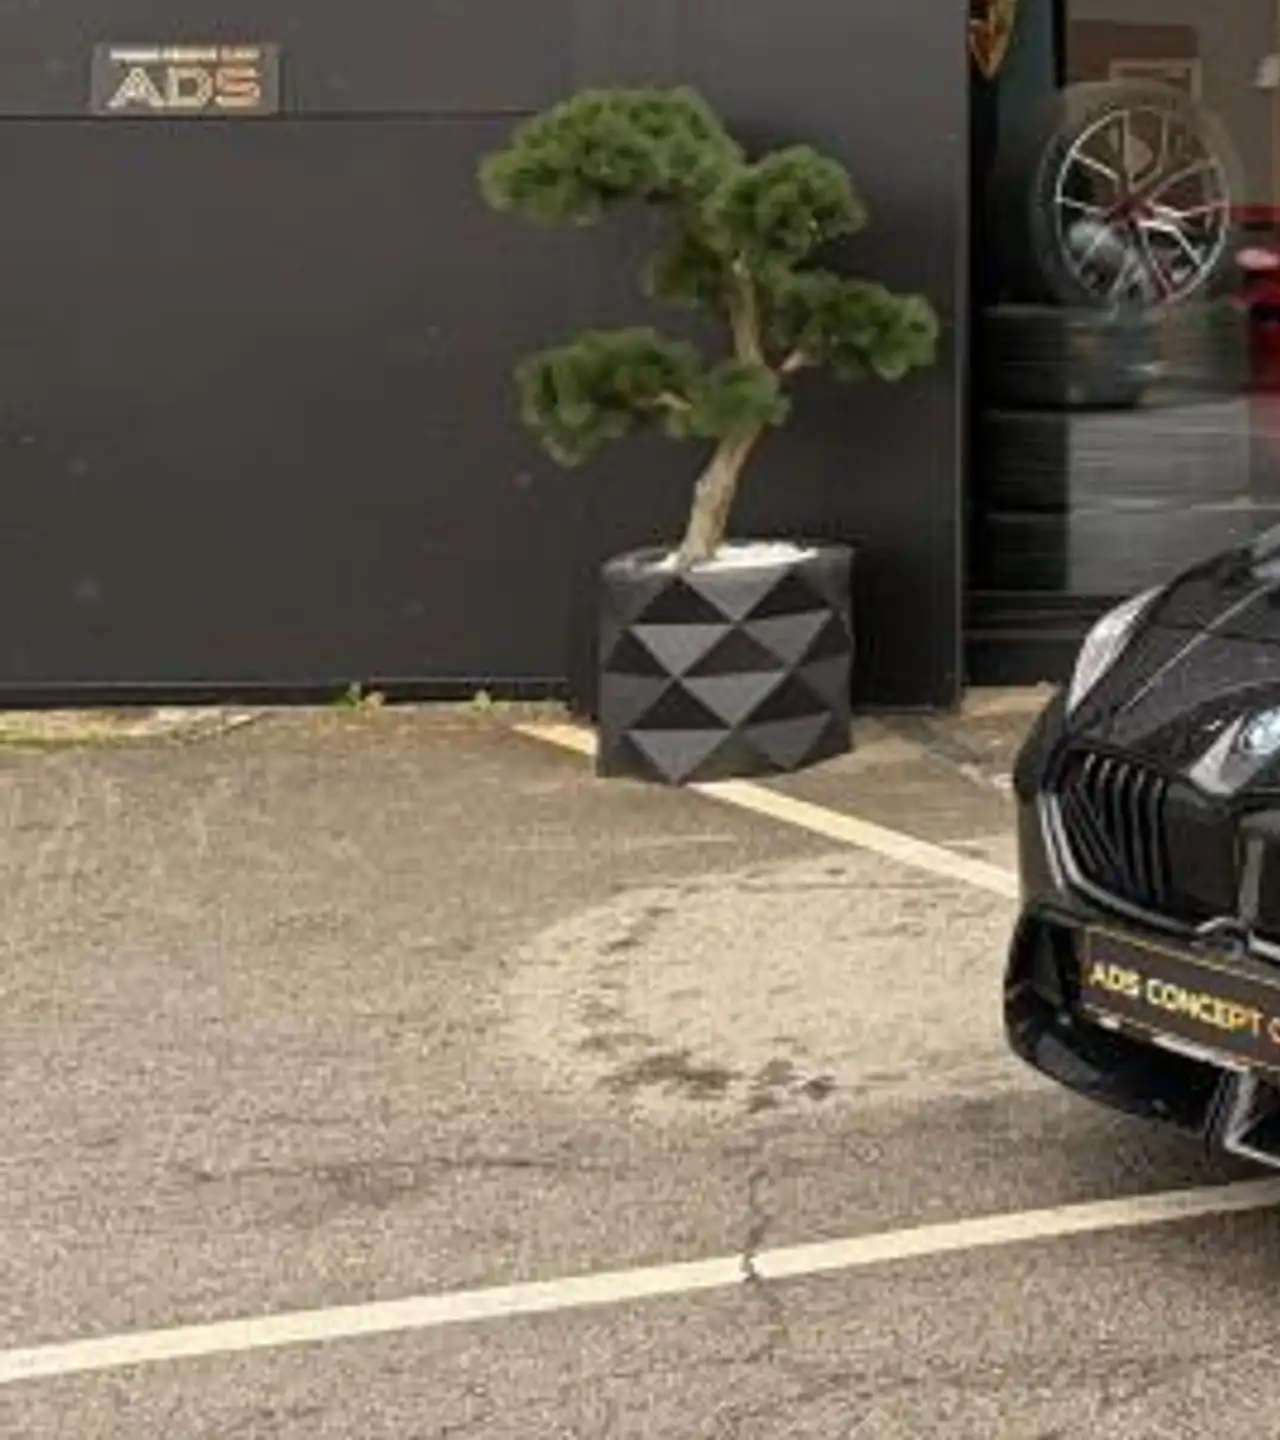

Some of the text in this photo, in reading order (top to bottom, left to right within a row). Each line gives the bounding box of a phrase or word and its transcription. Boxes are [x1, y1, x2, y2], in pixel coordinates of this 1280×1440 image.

[108, 66, 260, 107] ADS
[1089, 962, 1140, 998] ADS
[1145, 978, 1262, 1038] CONCEPT
